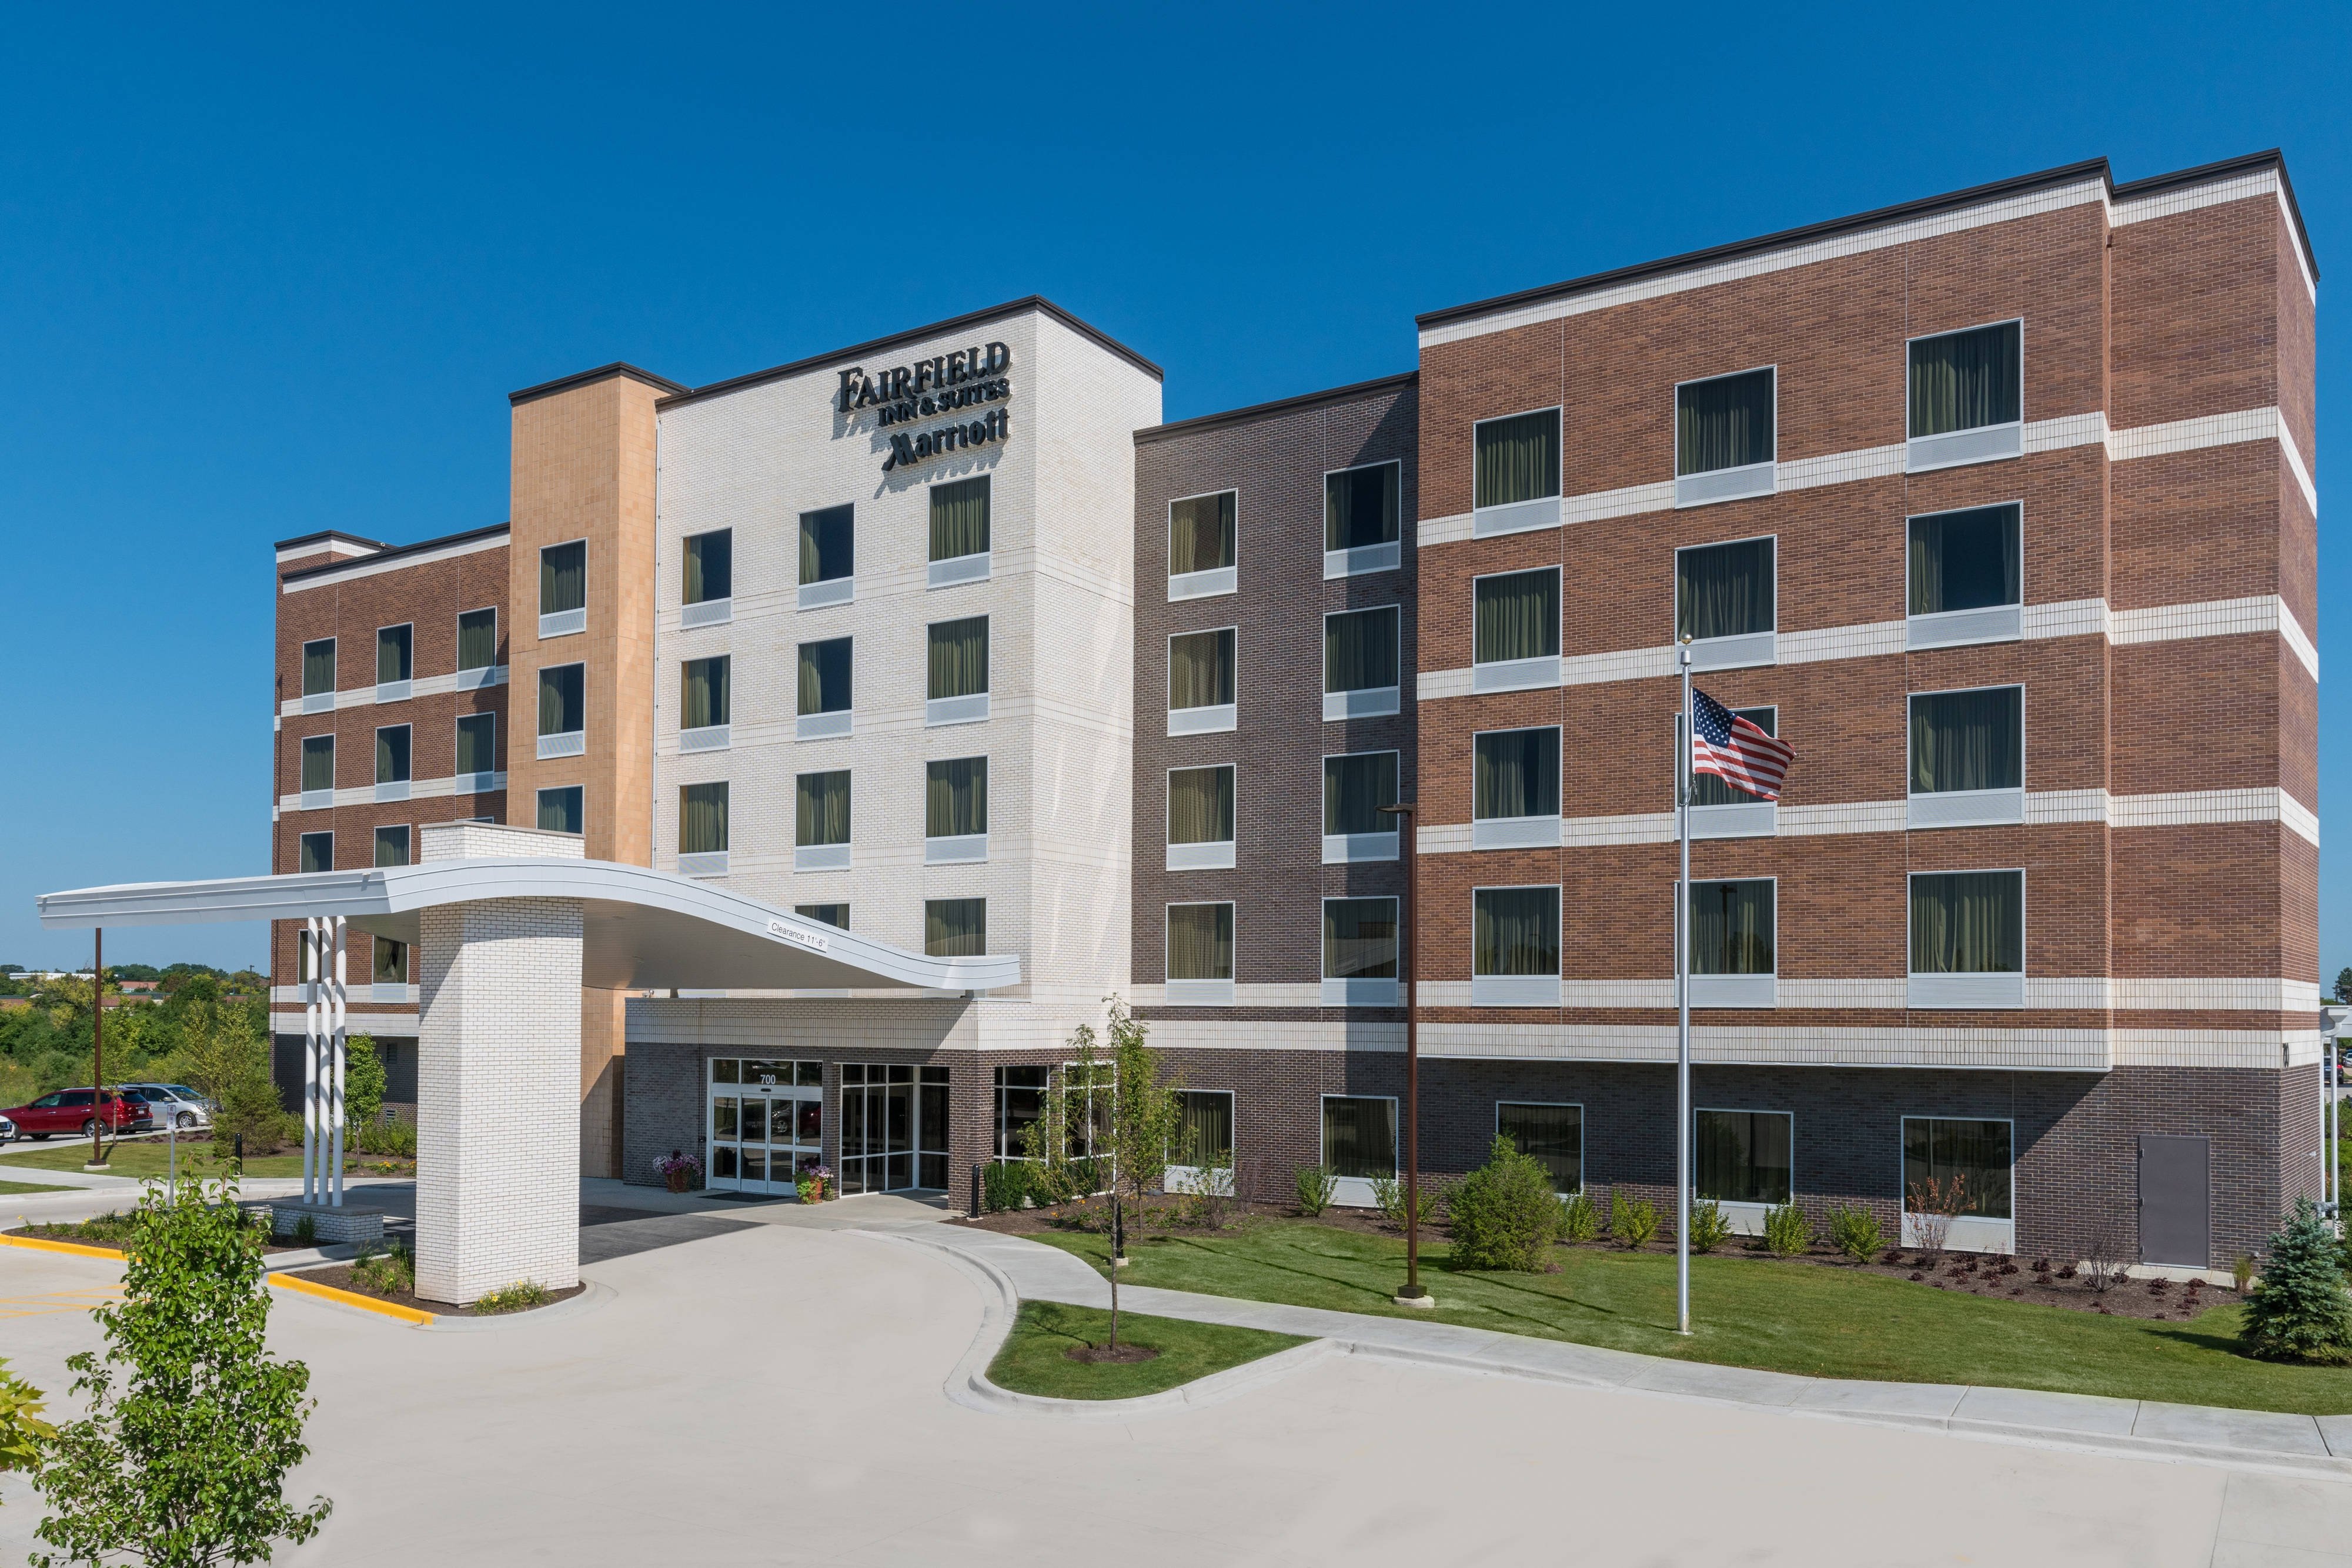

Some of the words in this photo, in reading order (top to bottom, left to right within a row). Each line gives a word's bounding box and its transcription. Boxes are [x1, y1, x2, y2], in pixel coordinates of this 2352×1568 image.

[838, 342, 1011, 412] FAIRFIELD
[881, 407, 1010, 471] Marriott
[771, 922, 805, 941] Clearance
[760, 1074, 776, 1085] 700
